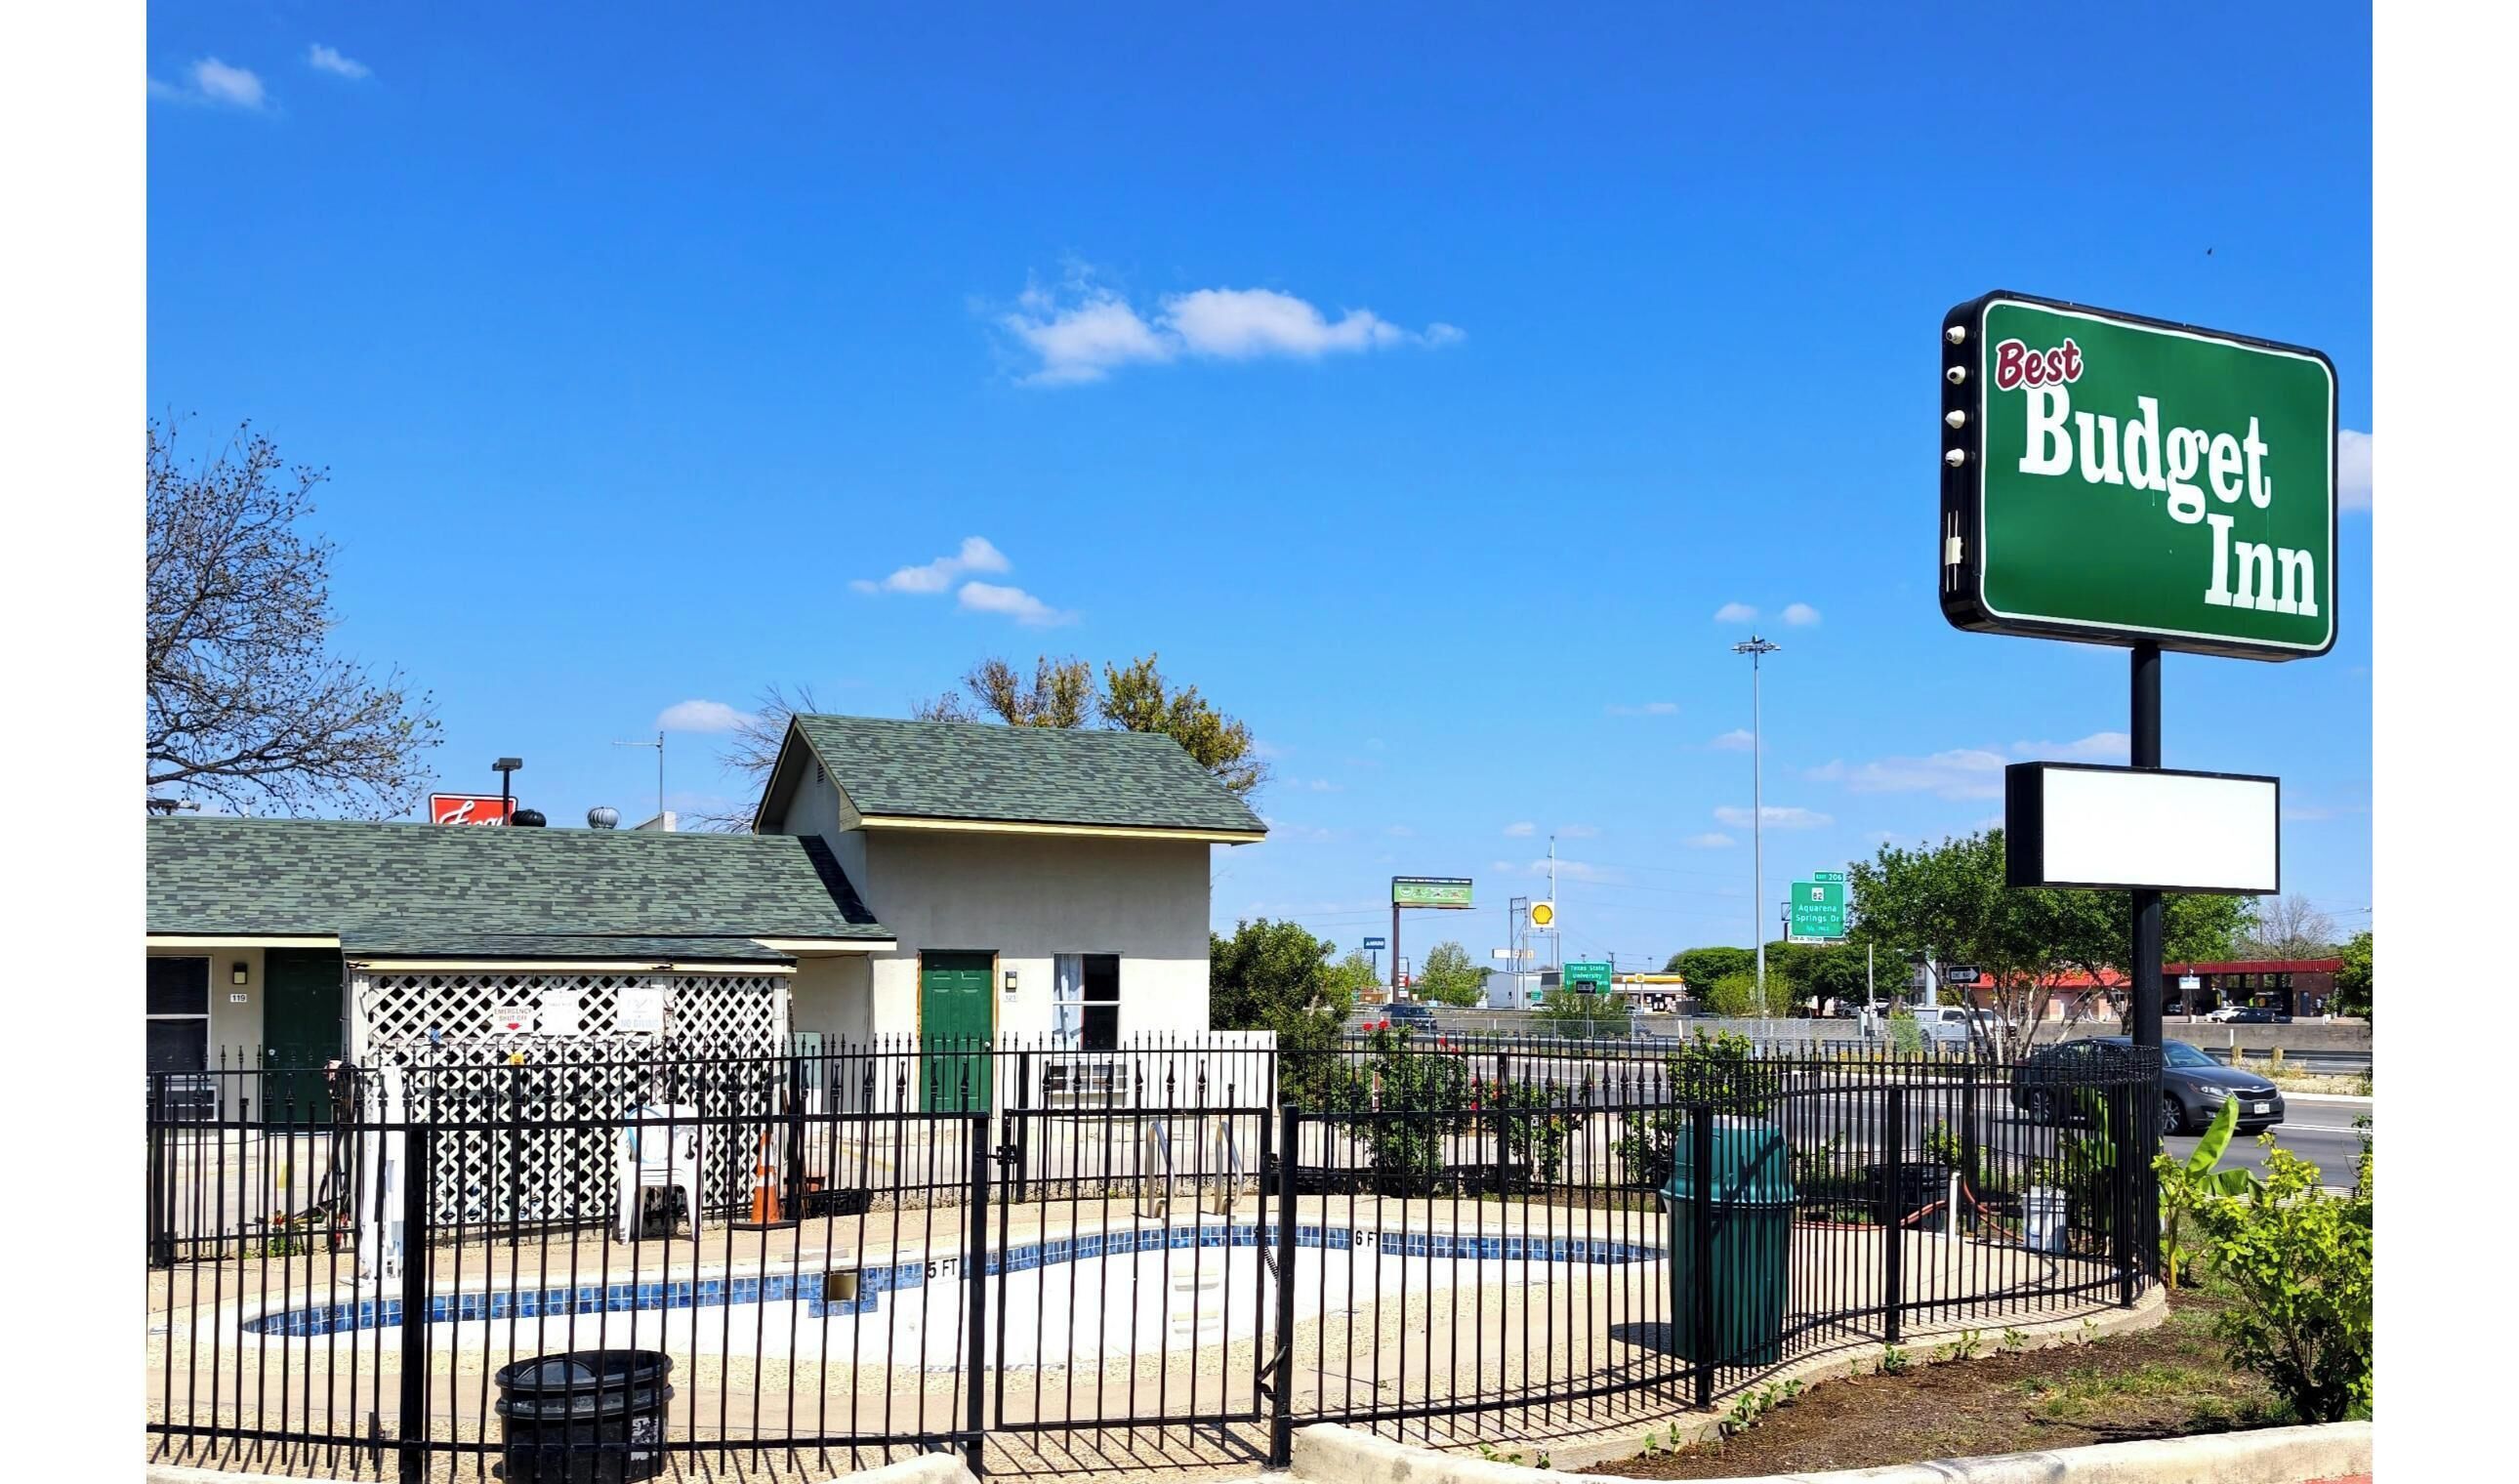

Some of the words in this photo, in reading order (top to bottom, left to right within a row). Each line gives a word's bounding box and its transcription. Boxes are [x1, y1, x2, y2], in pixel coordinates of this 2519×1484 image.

[1996, 338, 2083, 391] Best
[2018, 382, 2271, 523] Budget
[2204, 513, 2318, 617] Inn
[1812, 891, 1823, 900] 82
[1797, 904, 1837, 913] Aquarena
[1796, 914, 1827, 923] Springs
[1355, 1230, 1363, 1246] 6
[928, 1260, 937, 1279] 5
[942, 1257, 958, 1277] FT
